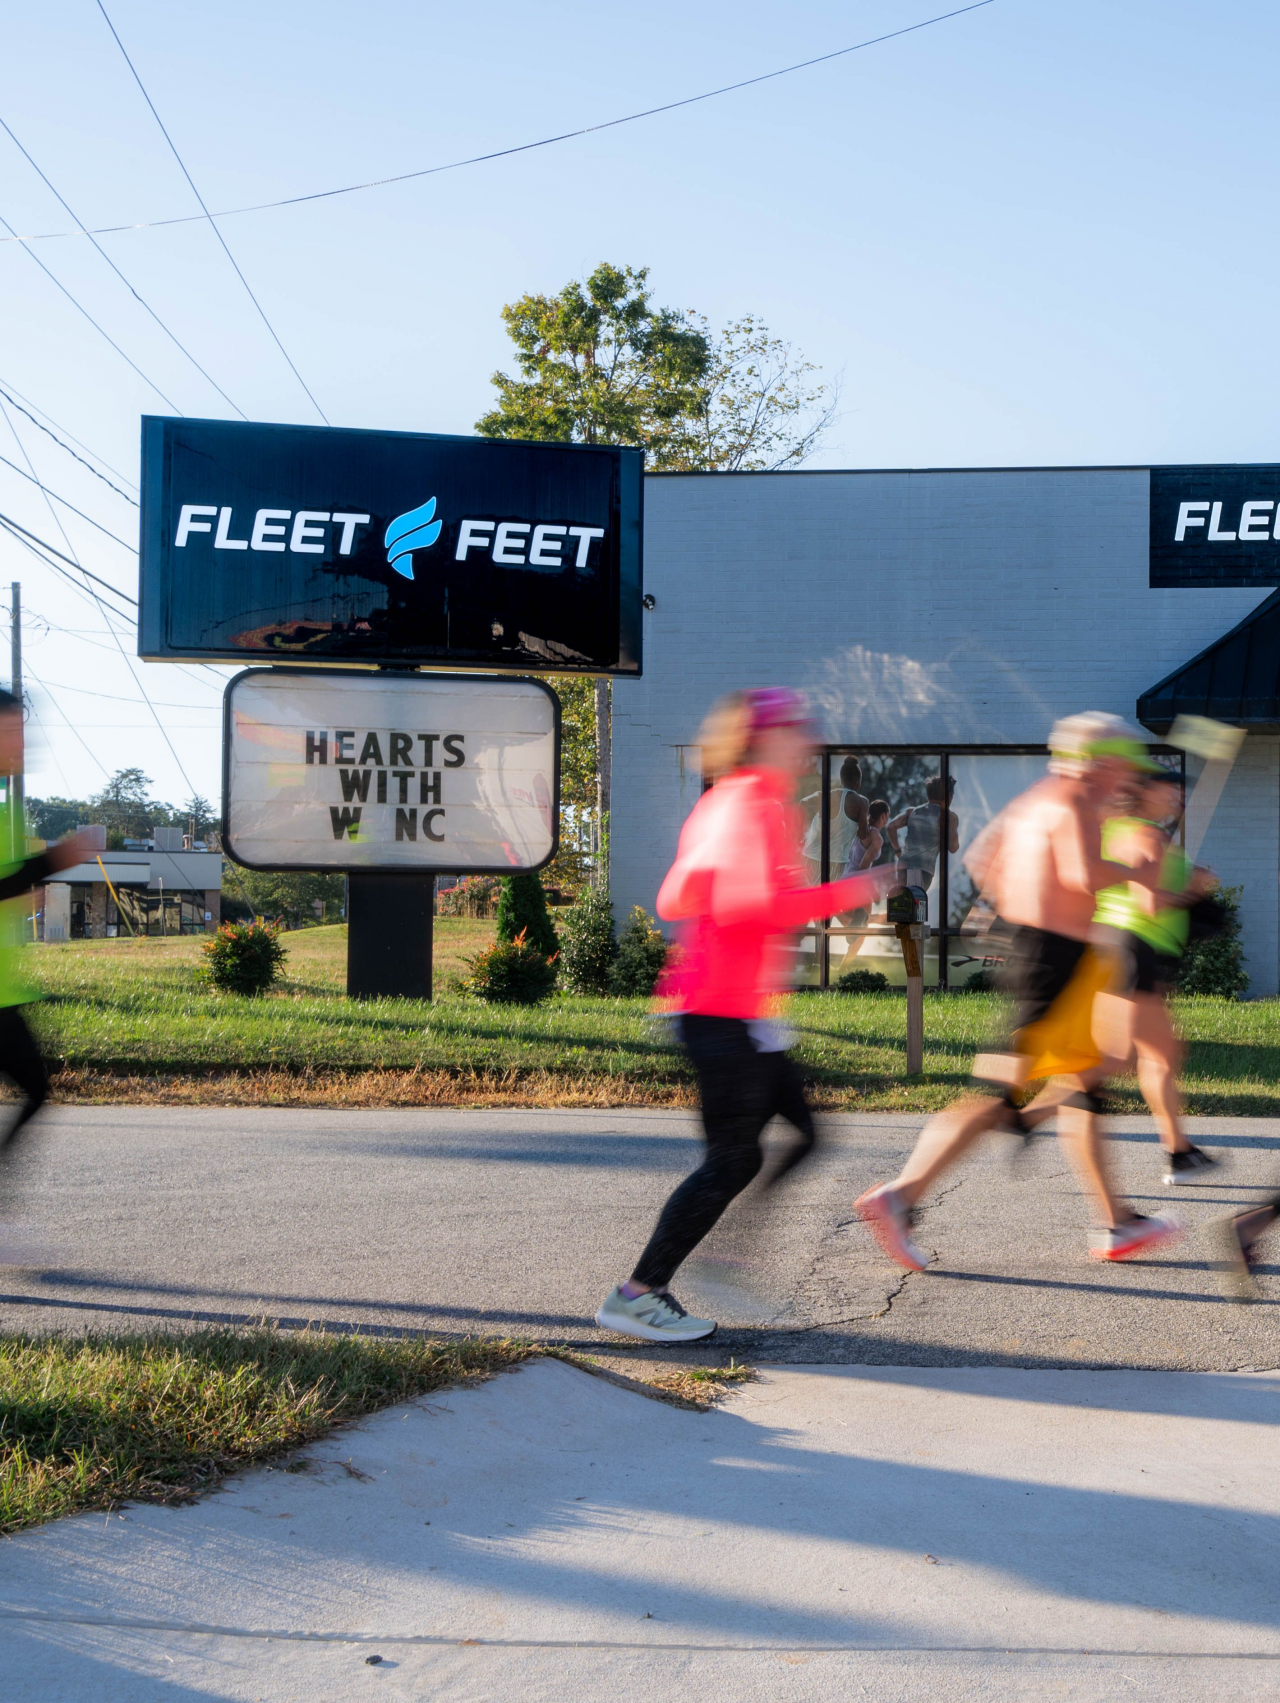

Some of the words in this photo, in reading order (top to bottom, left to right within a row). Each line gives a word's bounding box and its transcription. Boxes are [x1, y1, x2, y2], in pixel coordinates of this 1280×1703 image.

[174, 504, 371, 555] FLEET
[455, 519, 605, 568] FEET
[305, 730, 466, 768] HEARTS
[339, 768, 442, 804] WITH
